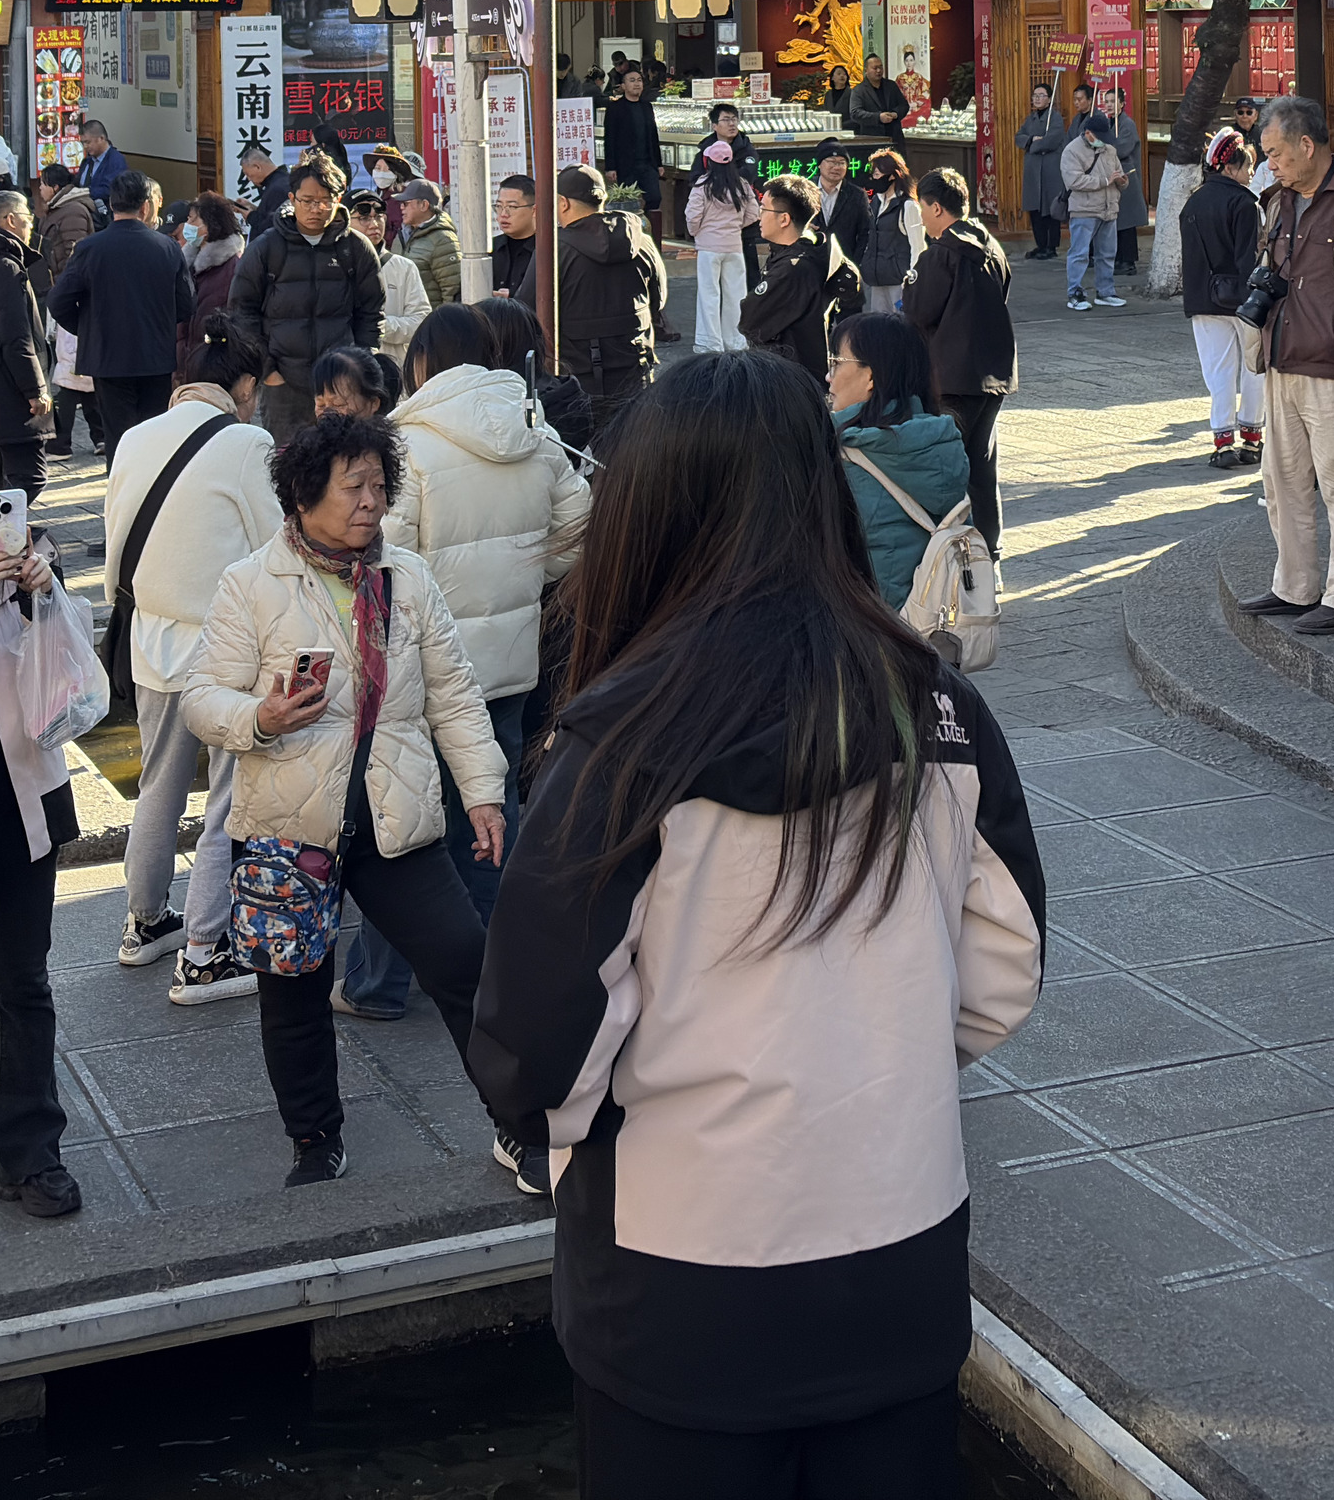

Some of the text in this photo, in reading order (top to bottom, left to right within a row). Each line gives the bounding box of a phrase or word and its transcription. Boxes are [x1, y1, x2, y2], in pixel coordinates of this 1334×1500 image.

[891, 5, 926, 14] 民族品牌
[37, 30, 81, 41] 大理味道
[284, 80, 385, 114] 雪花银
